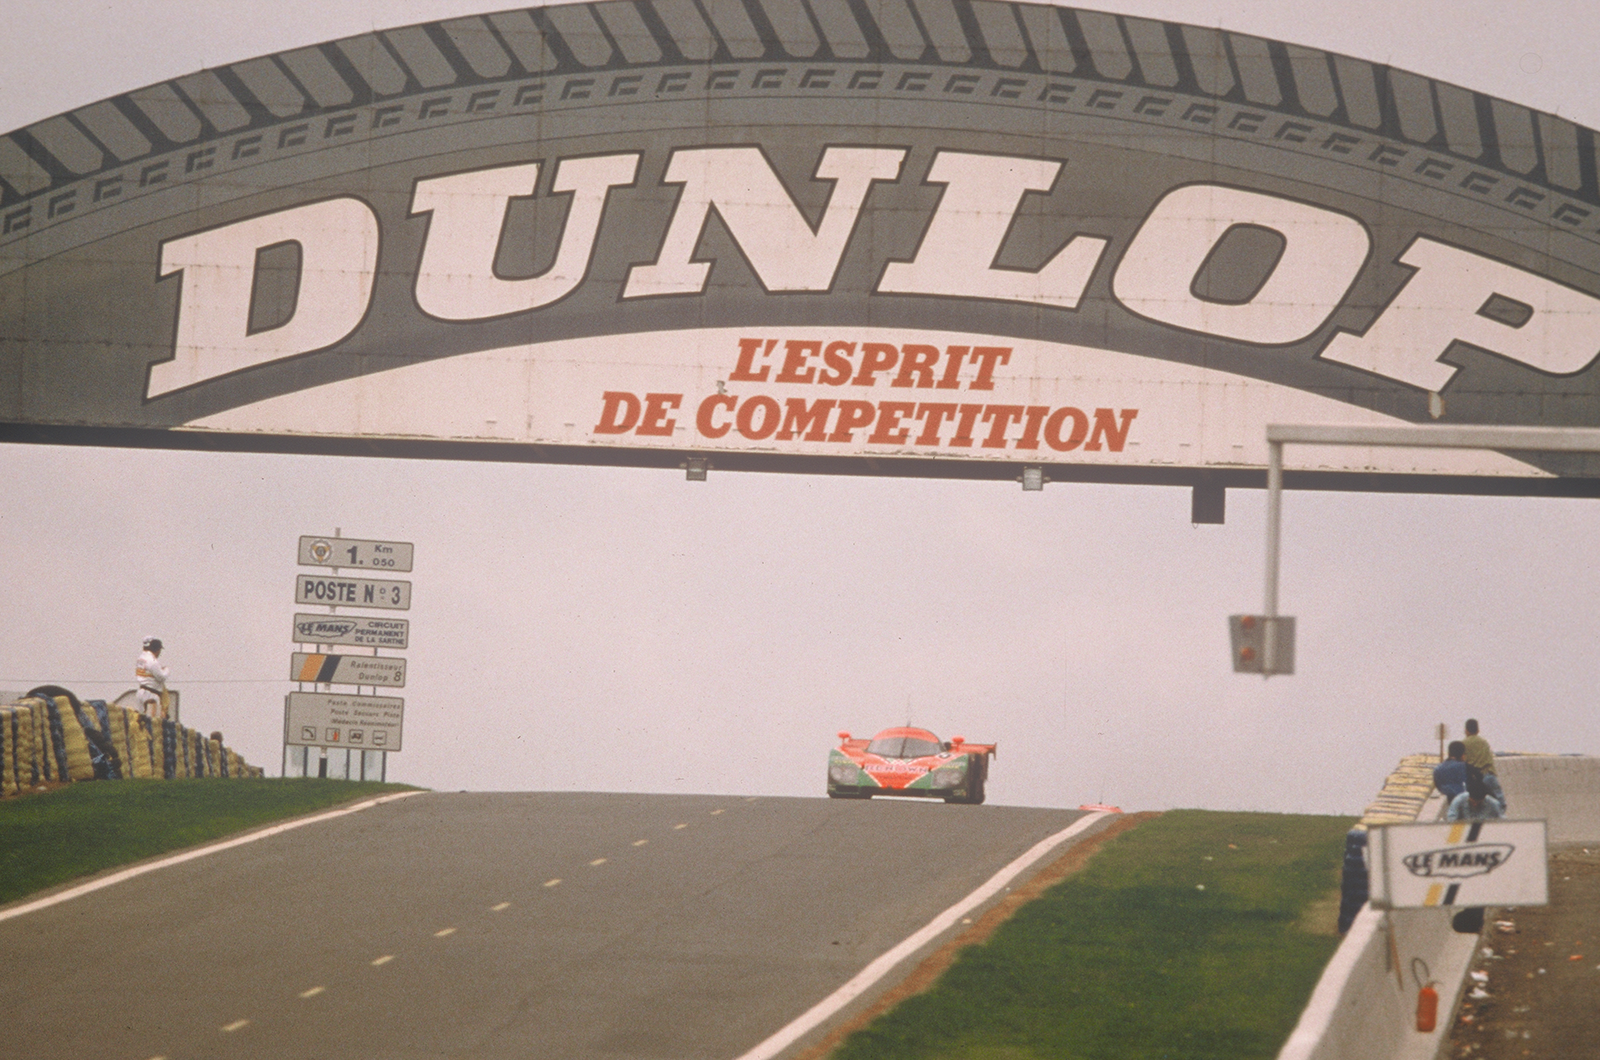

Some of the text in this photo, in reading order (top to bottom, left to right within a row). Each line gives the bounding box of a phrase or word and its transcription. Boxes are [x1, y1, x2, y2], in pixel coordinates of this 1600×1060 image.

[146, 144, 1600, 402] DUNLOP
[729, 337, 1013, 390] L'ESPRIT
[594, 391, 1138, 453] DE COMPETITION
[374, 544, 393, 554] Km
[304, 580, 357, 602] POSTE
[391, 586, 401, 605] 3
[315, 622, 350, 634] MANS
[368, 621, 405, 629] CIRCUIT
[355, 628, 405, 638] PERMANENT
[358, 672, 388, 682] Dunlop
[1412, 851, 1500, 868] LE MANS
